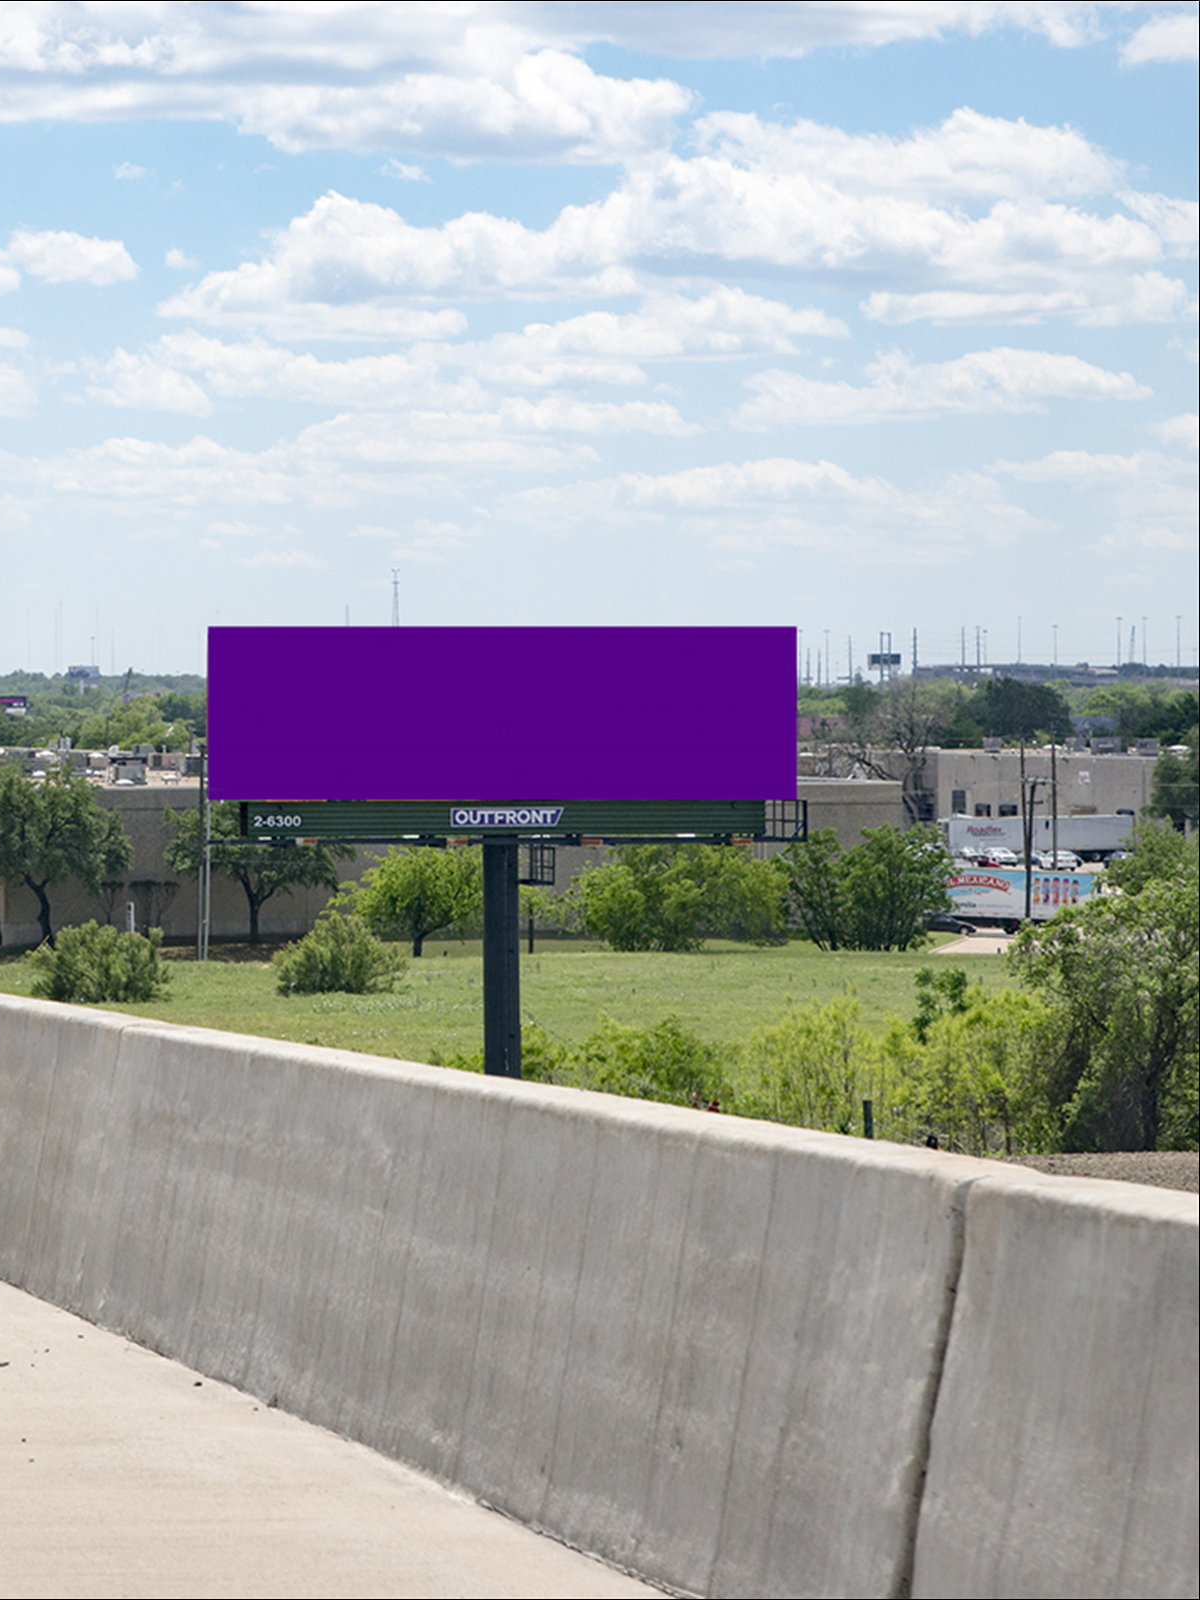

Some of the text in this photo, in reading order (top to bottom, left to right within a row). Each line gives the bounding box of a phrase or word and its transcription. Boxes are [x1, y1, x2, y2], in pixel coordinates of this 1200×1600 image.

[253, 810, 557, 827] 2-6300 OUTFRONT
[957, 875, 1009, 889] MEXICANO
